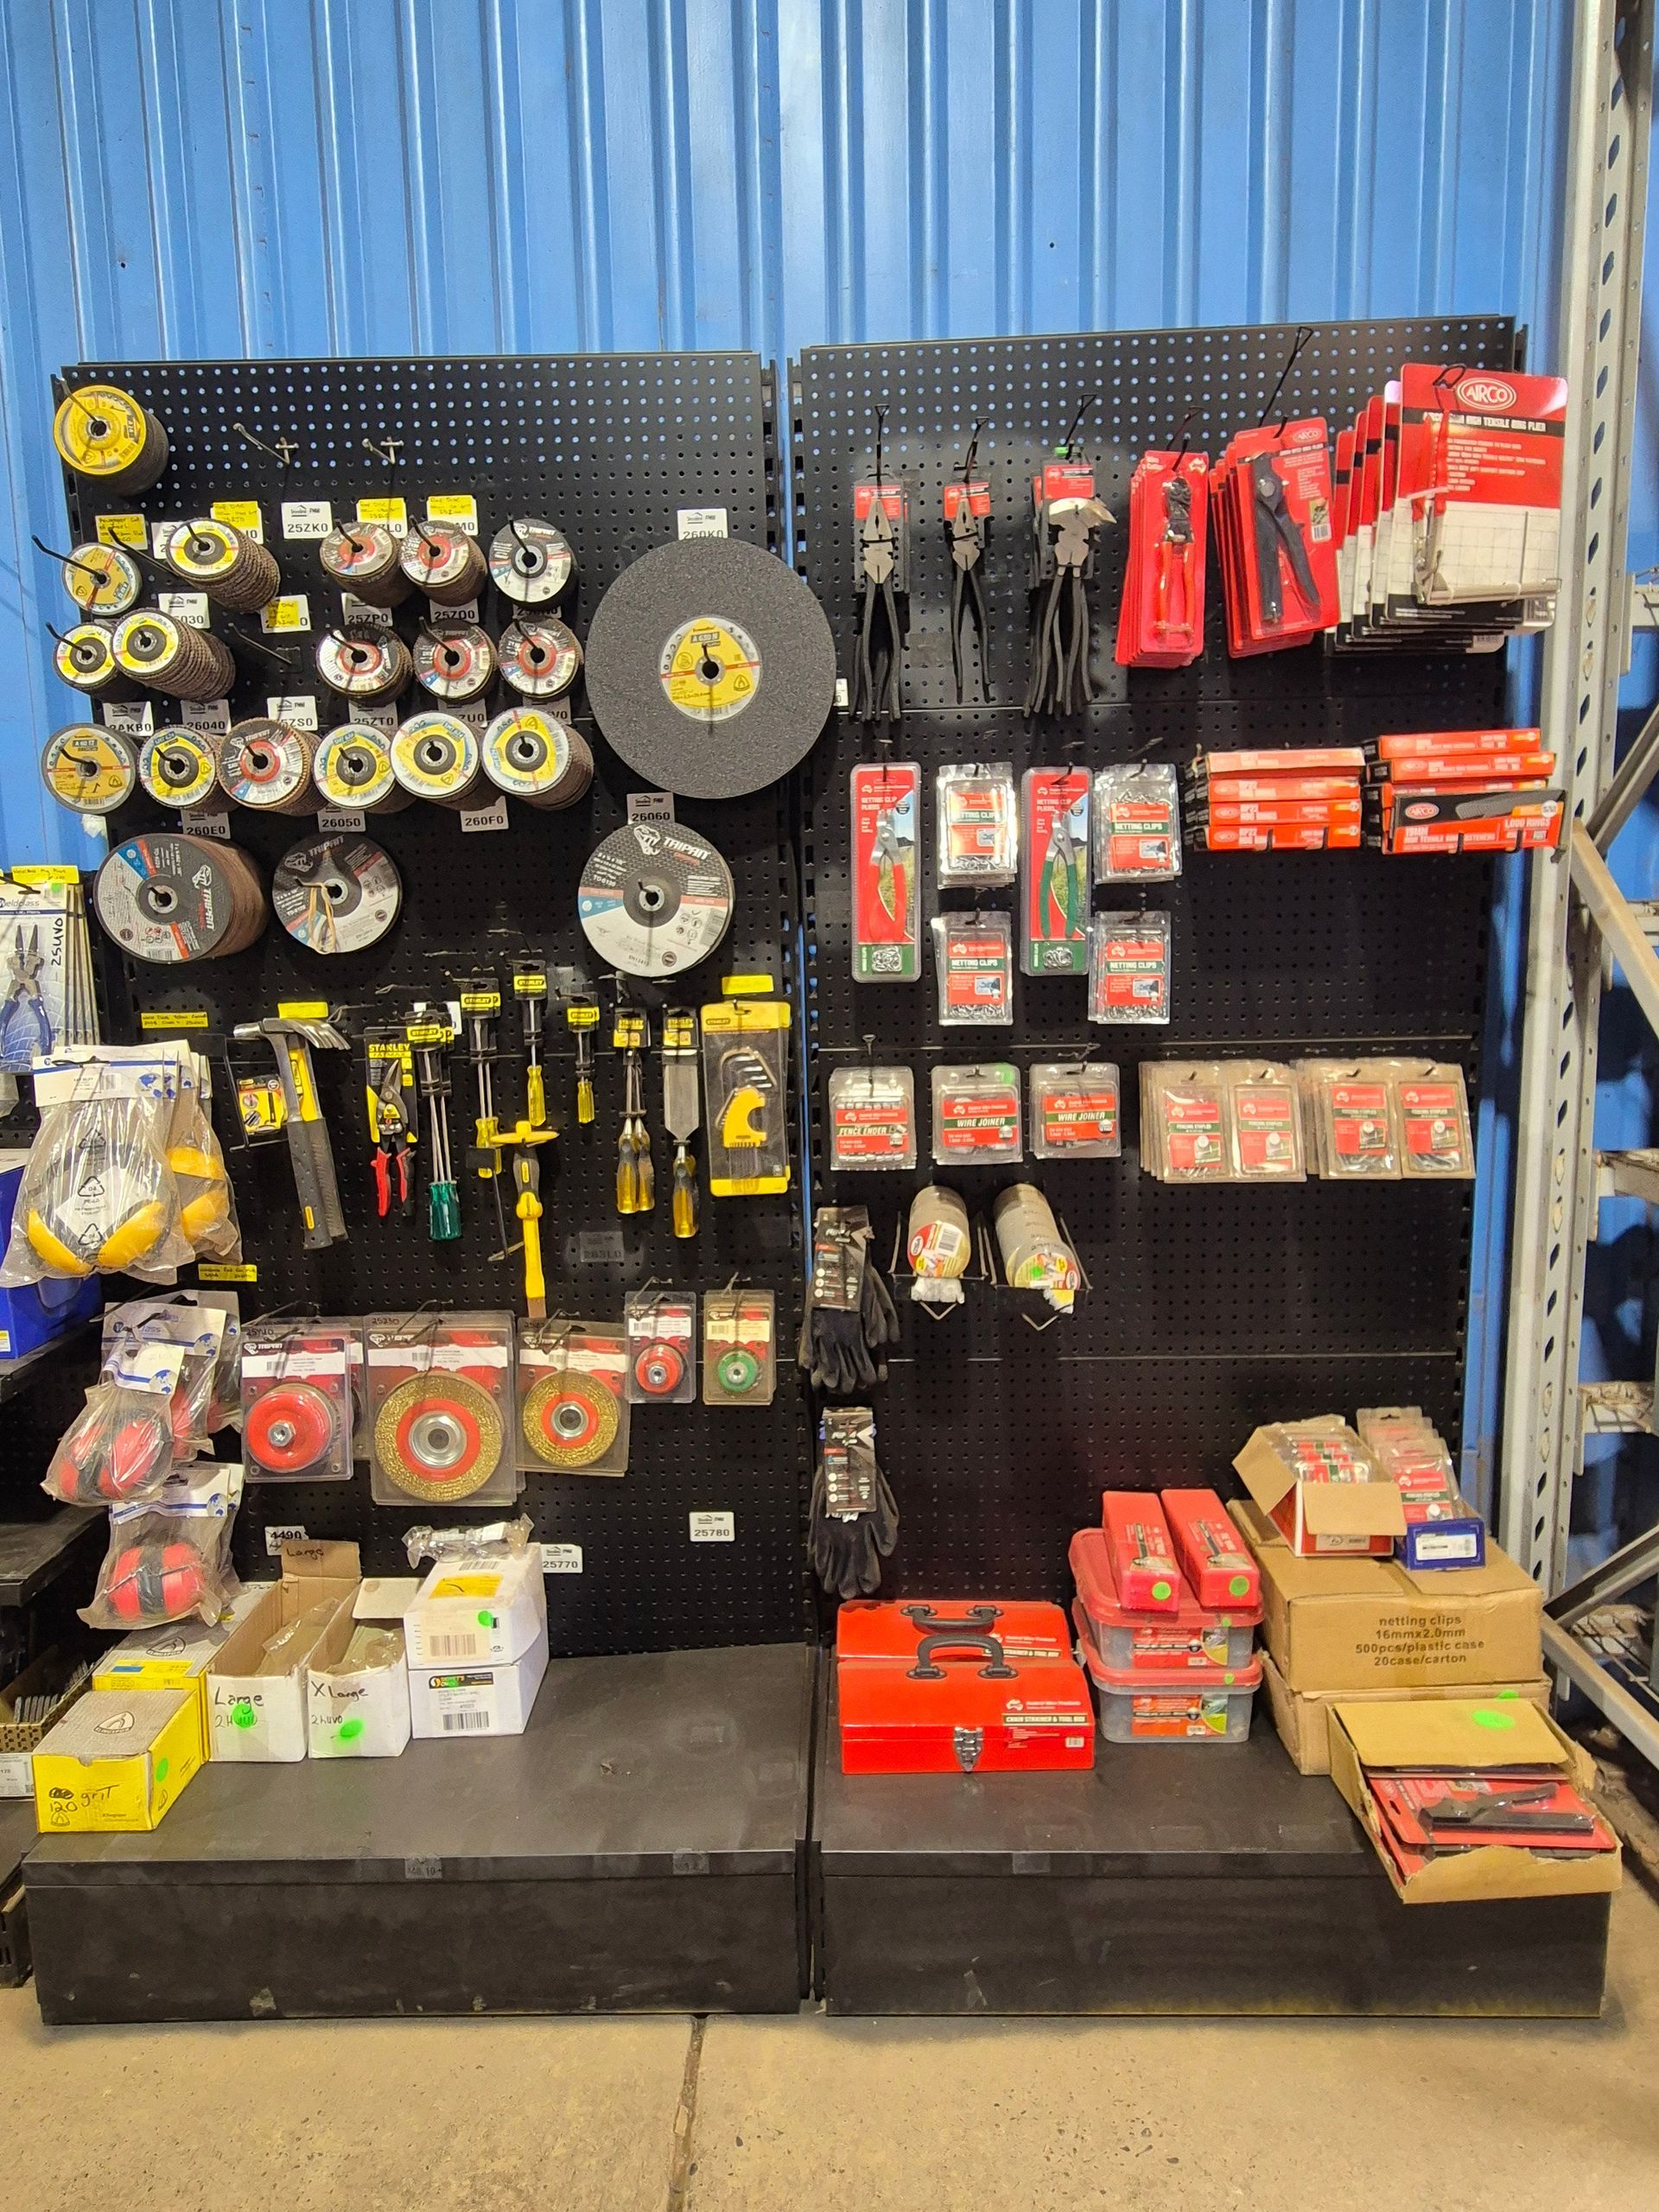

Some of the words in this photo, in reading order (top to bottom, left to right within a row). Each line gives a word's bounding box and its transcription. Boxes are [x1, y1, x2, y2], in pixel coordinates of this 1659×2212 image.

[1466, 385, 1508, 403] AIRCO
[287, 523, 329, 533] 25ZK0
[347, 613, 389, 624] 25ZP0
[465, 816, 504, 826] 260F0
[632, 811, 671, 822] 26060
[321, 817, 361, 828] 26050
[186, 825, 226, 836] 260E0
[664, 836, 711, 860] TAIPAN
[368, 1043, 410, 1052] STANLEY
[1058, 1113, 1077, 1122] WIRE
[1077, 1111, 1106, 1121] JOINER
[957, 1118, 977, 1128] WIRE
[977, 1117, 1006, 1127] JOINER
[694, 1529, 730, 1537] 25780
[286, 1548, 324, 1560] Large
[543, 1560, 578, 1569] 25770
[1379, 1616, 1427, 1627] netting
[1429, 1615, 1462, 1626] clips
[1376, 1627, 1466, 1640] 16mmx2.0mm
[1356, 1641, 1452, 1655] 500pcs/plastic
[1454, 1641, 1484, 1649] case
[1374, 1655, 1467, 1666] 20case/carton
[311, 1681, 326, 1697] X
[327, 1685, 369, 1701] Large
[214, 1687, 264, 1714] Large
[49, 1802, 78, 1813] 120
